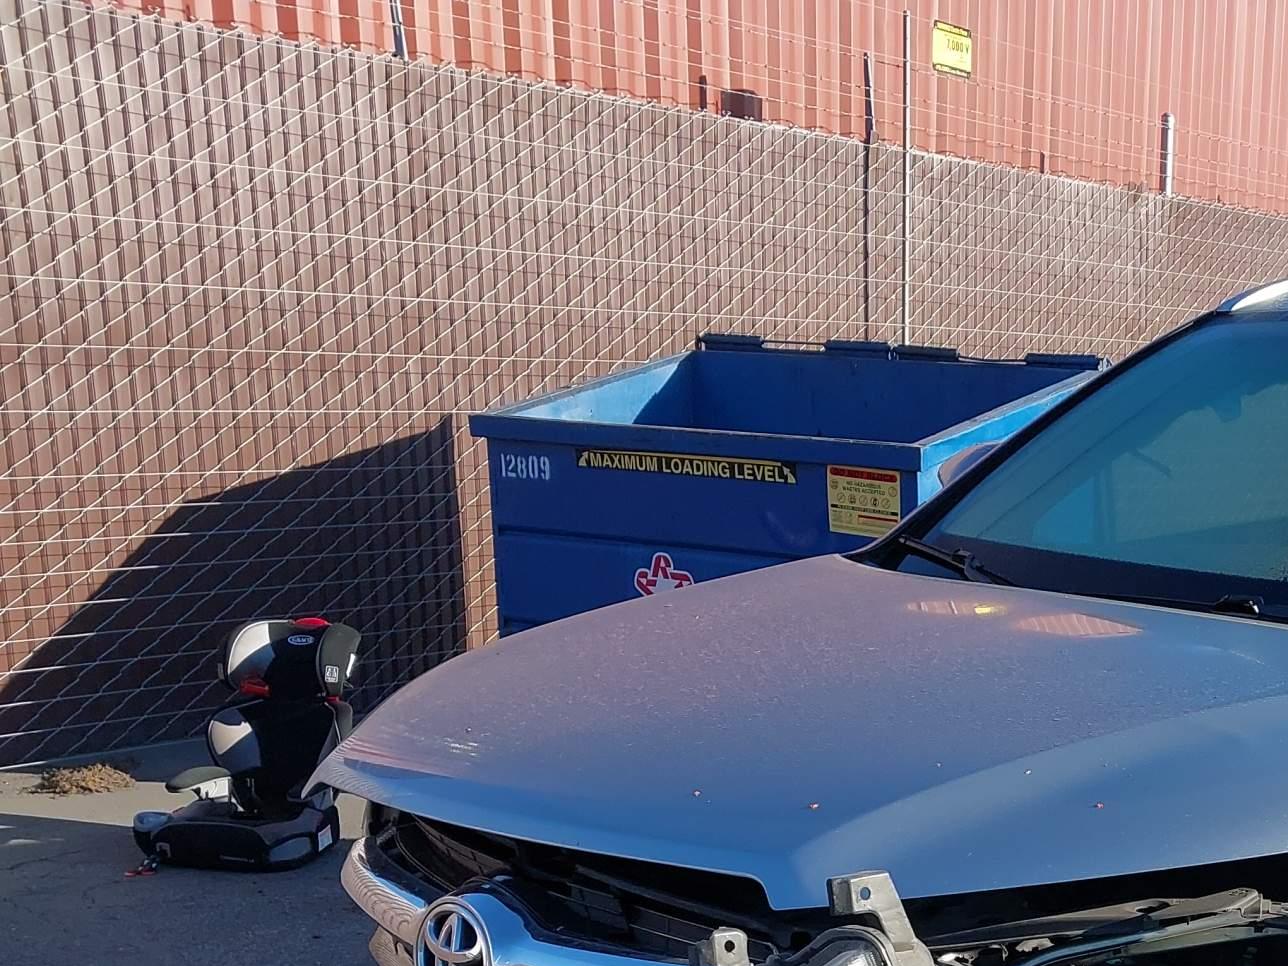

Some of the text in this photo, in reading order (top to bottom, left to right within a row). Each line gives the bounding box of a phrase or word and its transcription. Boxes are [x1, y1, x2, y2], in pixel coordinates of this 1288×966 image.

[500, 453, 550, 480] 12809
[589, 452, 785, 483] MAXIMUM LOADING LEVEL
